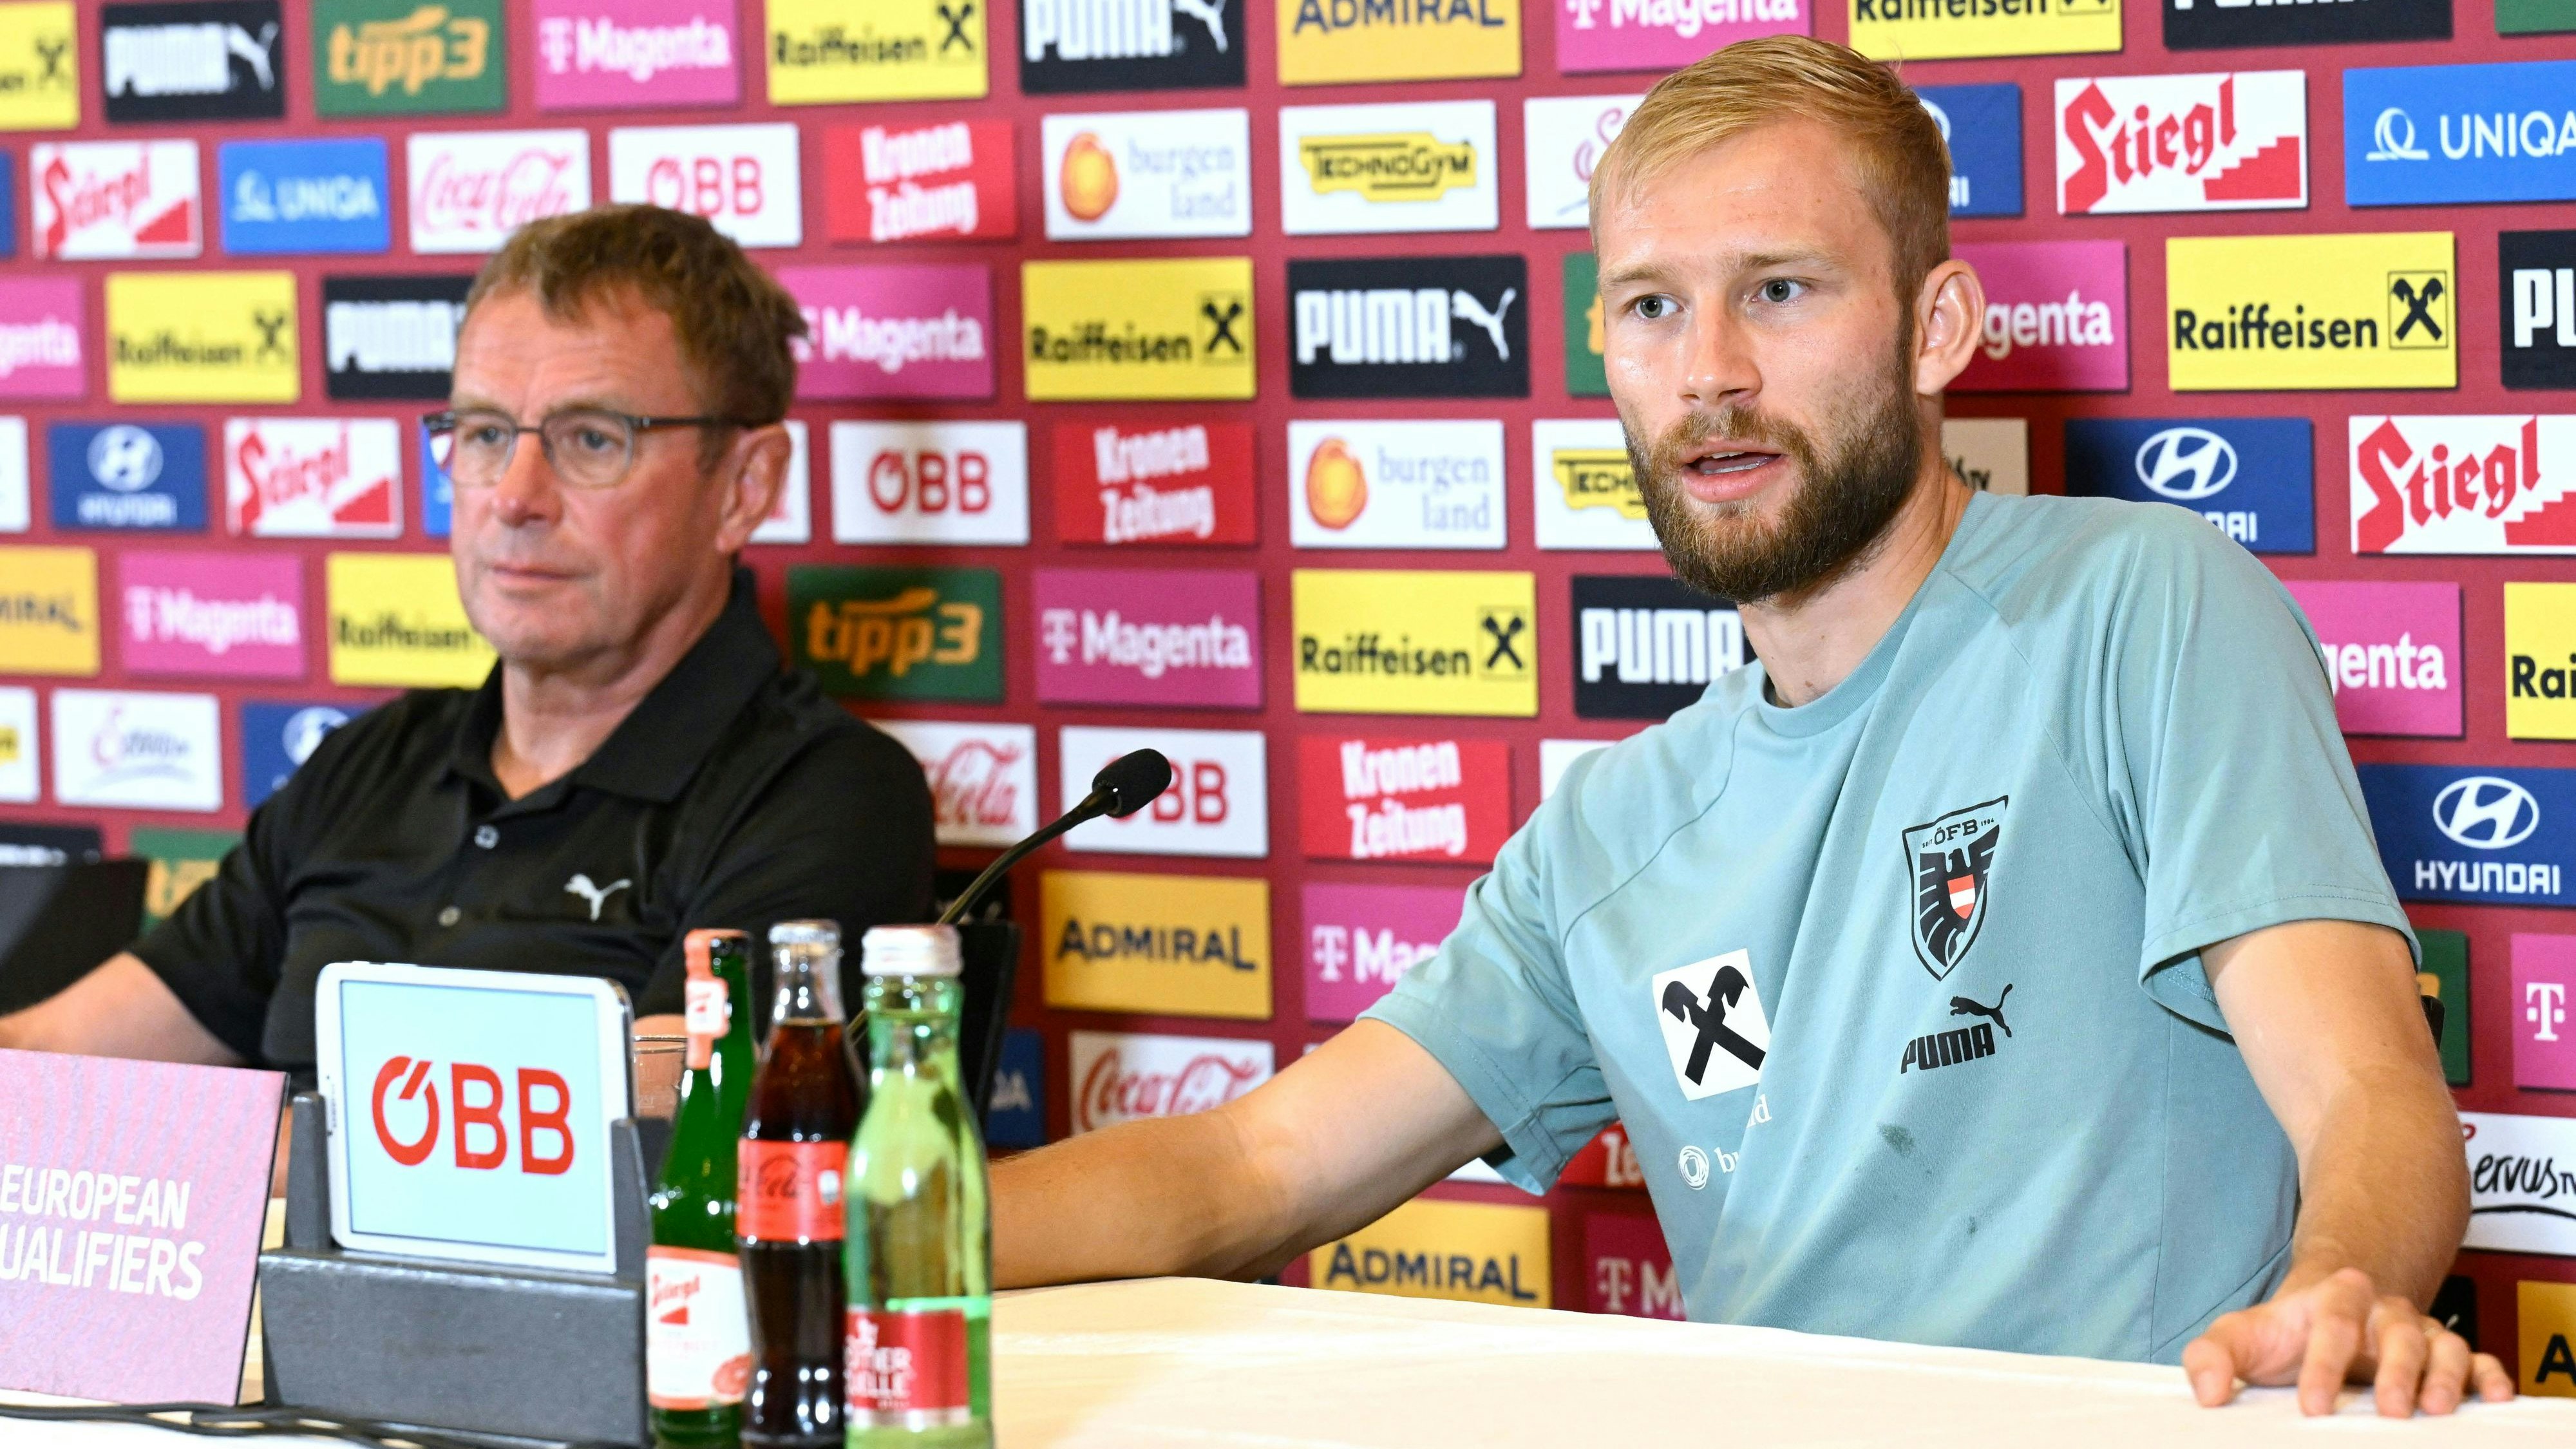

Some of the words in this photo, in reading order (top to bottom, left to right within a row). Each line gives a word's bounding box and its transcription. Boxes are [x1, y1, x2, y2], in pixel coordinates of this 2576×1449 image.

[775, 24, 928, 66] Raiffeisen
[1128, 139, 1236, 178] burgen
[2064, 72, 2237, 213] Stiegl
[1170, 187, 1236, 221] land
[1031, 321, 1192, 364] Raiffeisen
[1294, 288, 1452, 365] PUMA
[2175, 304, 2379, 349] Raiffeisen
[1094, 425, 1211, 484] Kronen
[1378, 444, 1490, 489] burgen
[2357, 416, 2541, 552] Stiegl
[1421, 495, 1491, 531] land
[807, 588, 983, 676] tipp3
[1081, 610, 1251, 678] Magenta
[1300, 634, 1471, 677] Raiffeisen
[1580, 608, 1743, 684] PUMA
[1340, 741, 1462, 800] Kronen
[1347, 800, 1467, 859] Zeitung
[1934, 819, 1978, 846] ÖFB
[2415, 860, 2561, 895] HYUNDAI
[1056, 914, 1256, 971] ADMIRAL
[1900, 1023, 1996, 1074] PUMA
[372, 1055, 575, 1176] ÖBB
[0, 1164, 191, 1230] EUROPEAN
[1327, 1242, 1536, 1300] ADMIRAL
